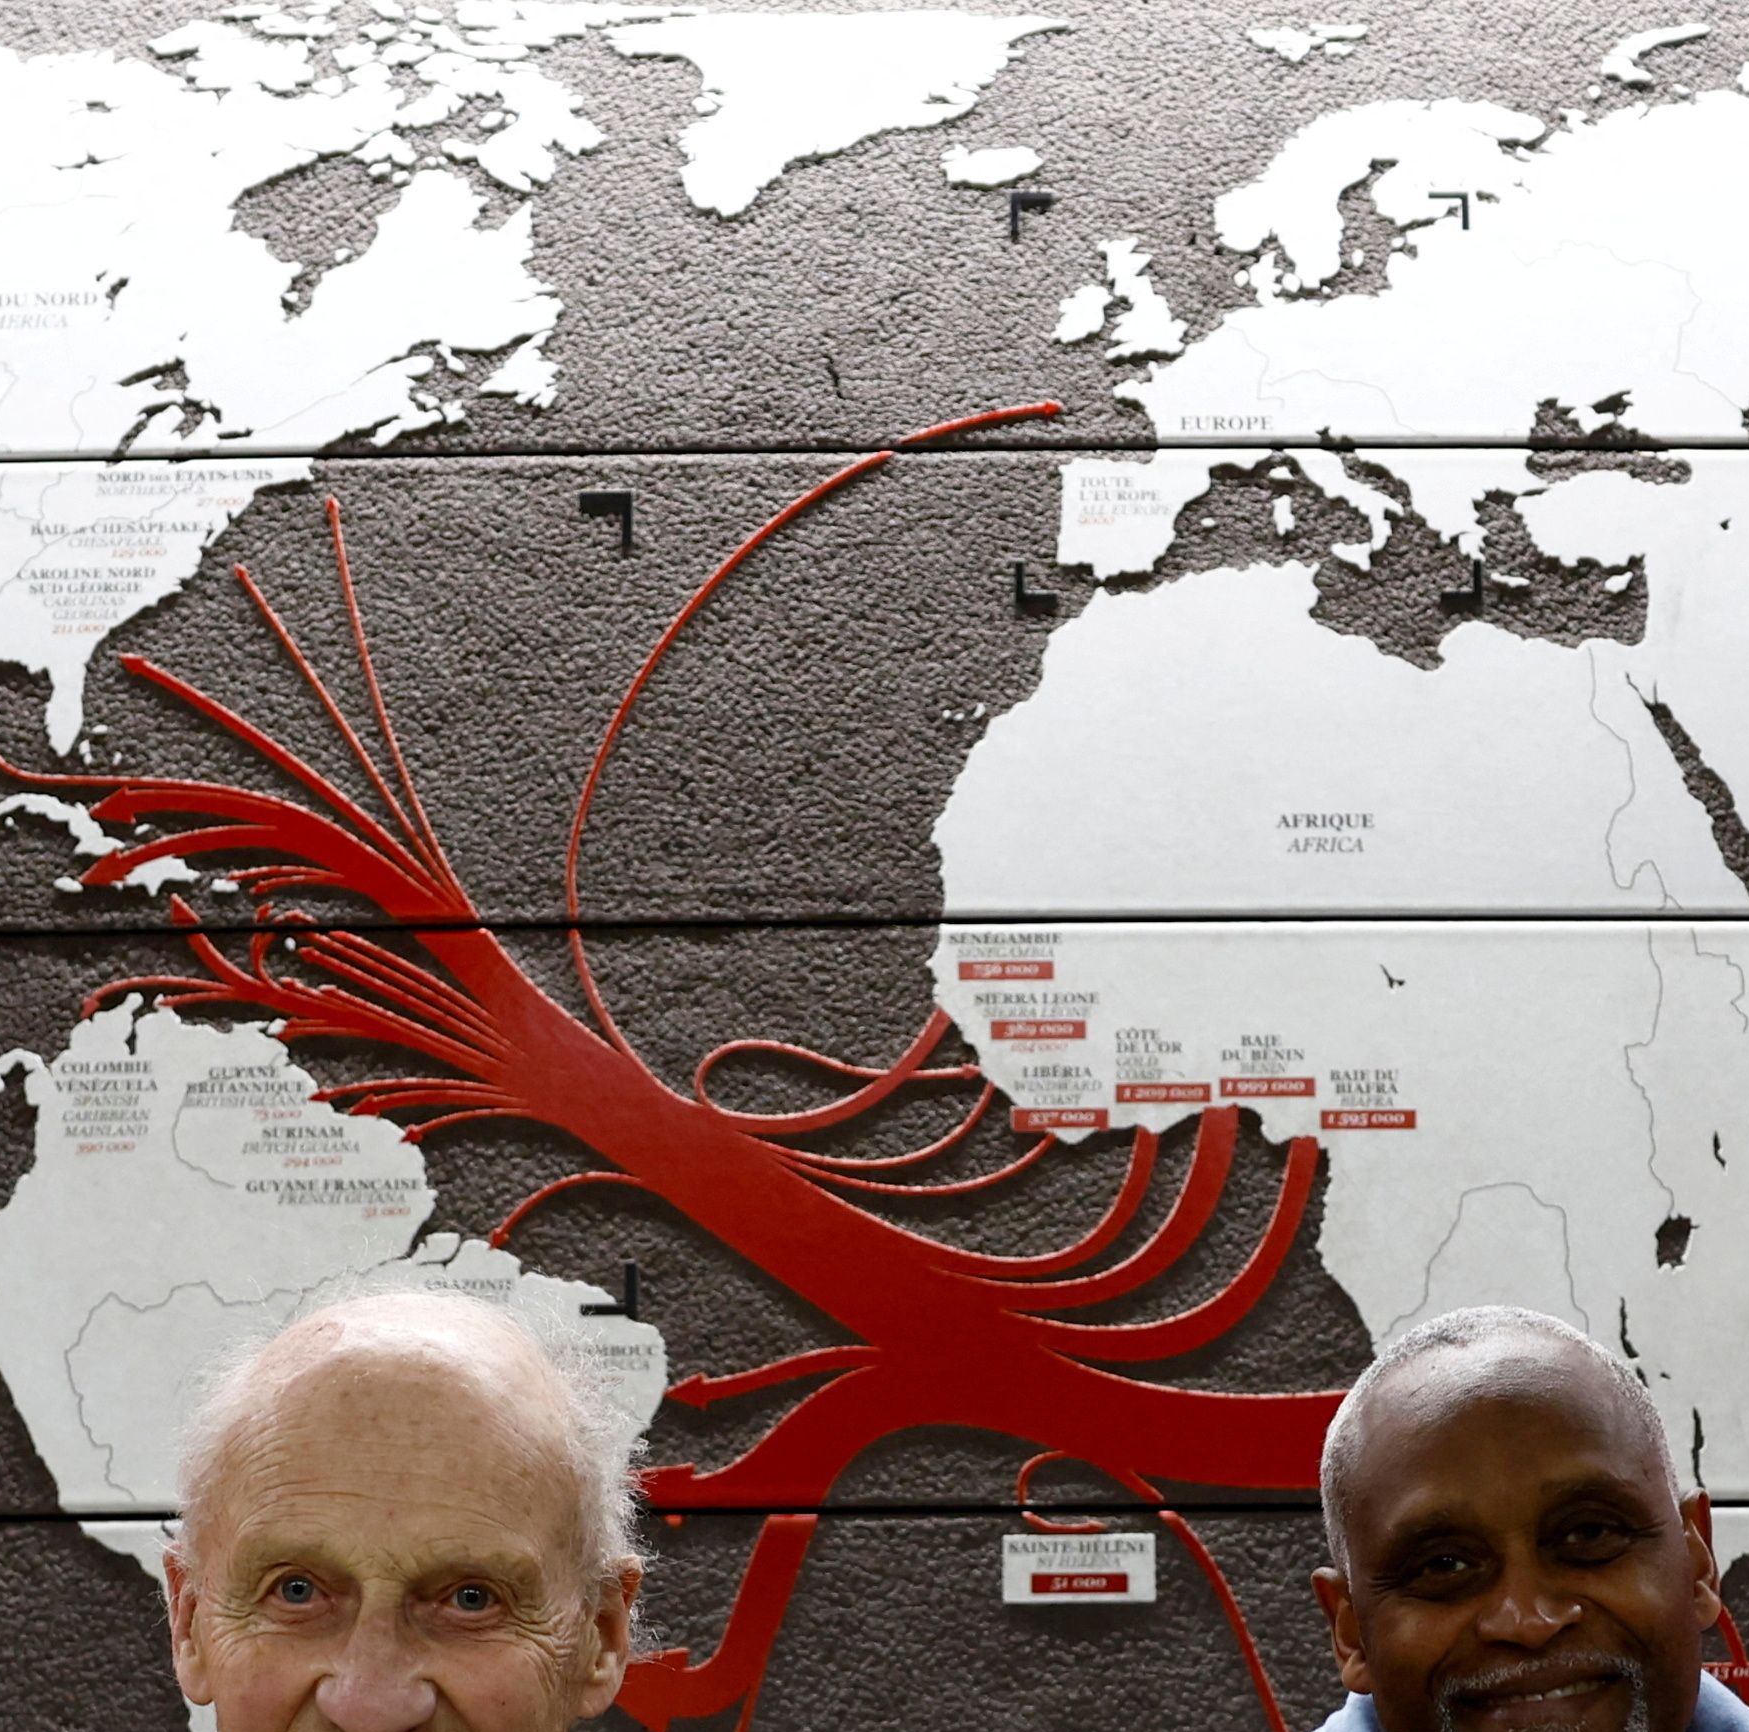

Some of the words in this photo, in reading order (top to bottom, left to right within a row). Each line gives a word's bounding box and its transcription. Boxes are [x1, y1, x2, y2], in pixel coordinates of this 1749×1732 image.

[34, 291, 98, 307] NORD
[1180, 415, 1274, 431] EUROPE
[96, 471, 145, 482] NORD
[1080, 476, 1134, 488] TOUTE
[1079, 489, 1160, 501] L'EUROPE
[16, 568, 96, 581] CAROLINE
[101, 566, 156, 579] NORD
[28, 583, 64, 595] SUD
[1275, 812, 1375, 832] AFRIQUE
[1287, 836, 1364, 853] AFRICA
[949, 931, 1063, 945] SÉNÉGAMBIE
[974, 991, 1038, 1006] SIERRA
[1042, 991, 1099, 1005] LEONE
[1116, 1026, 1162, 1042] CÔTE
[1241, 1034, 1282, 1048] BAIE
[1116, 1042, 1143, 1054] DE
[1147, 1041, 1182, 1054] L'OR
[1221, 1049, 1248, 1062] DU
[1252, 1046, 1305, 1061] BÉNIN
[60, 1060, 152, 1075] COLOMBIE
[208, 1066, 281, 1079] GUYANE
[1022, 1063, 1093, 1079] LIBÉRIA
[1330, 1069, 1370, 1082] BAIE
[1373, 1069, 1399, 1082] DU
[55, 1077, 158, 1093] VÉNÉZUELA
[185, 1080, 304, 1095] BRITANNIQUE
[1335, 1082, 1398, 1096] BIAFRA
[63, 1125, 148, 1138] MAINLAND
[261, 1126, 344, 1139] SURINAM
[241, 1142, 296, 1155] DUTCH
[299, 1141, 361, 1154] GUIANA
[245, 1178, 320, 1192] GUYANE
[323, 1178, 422, 1194] FRANÇAISE
